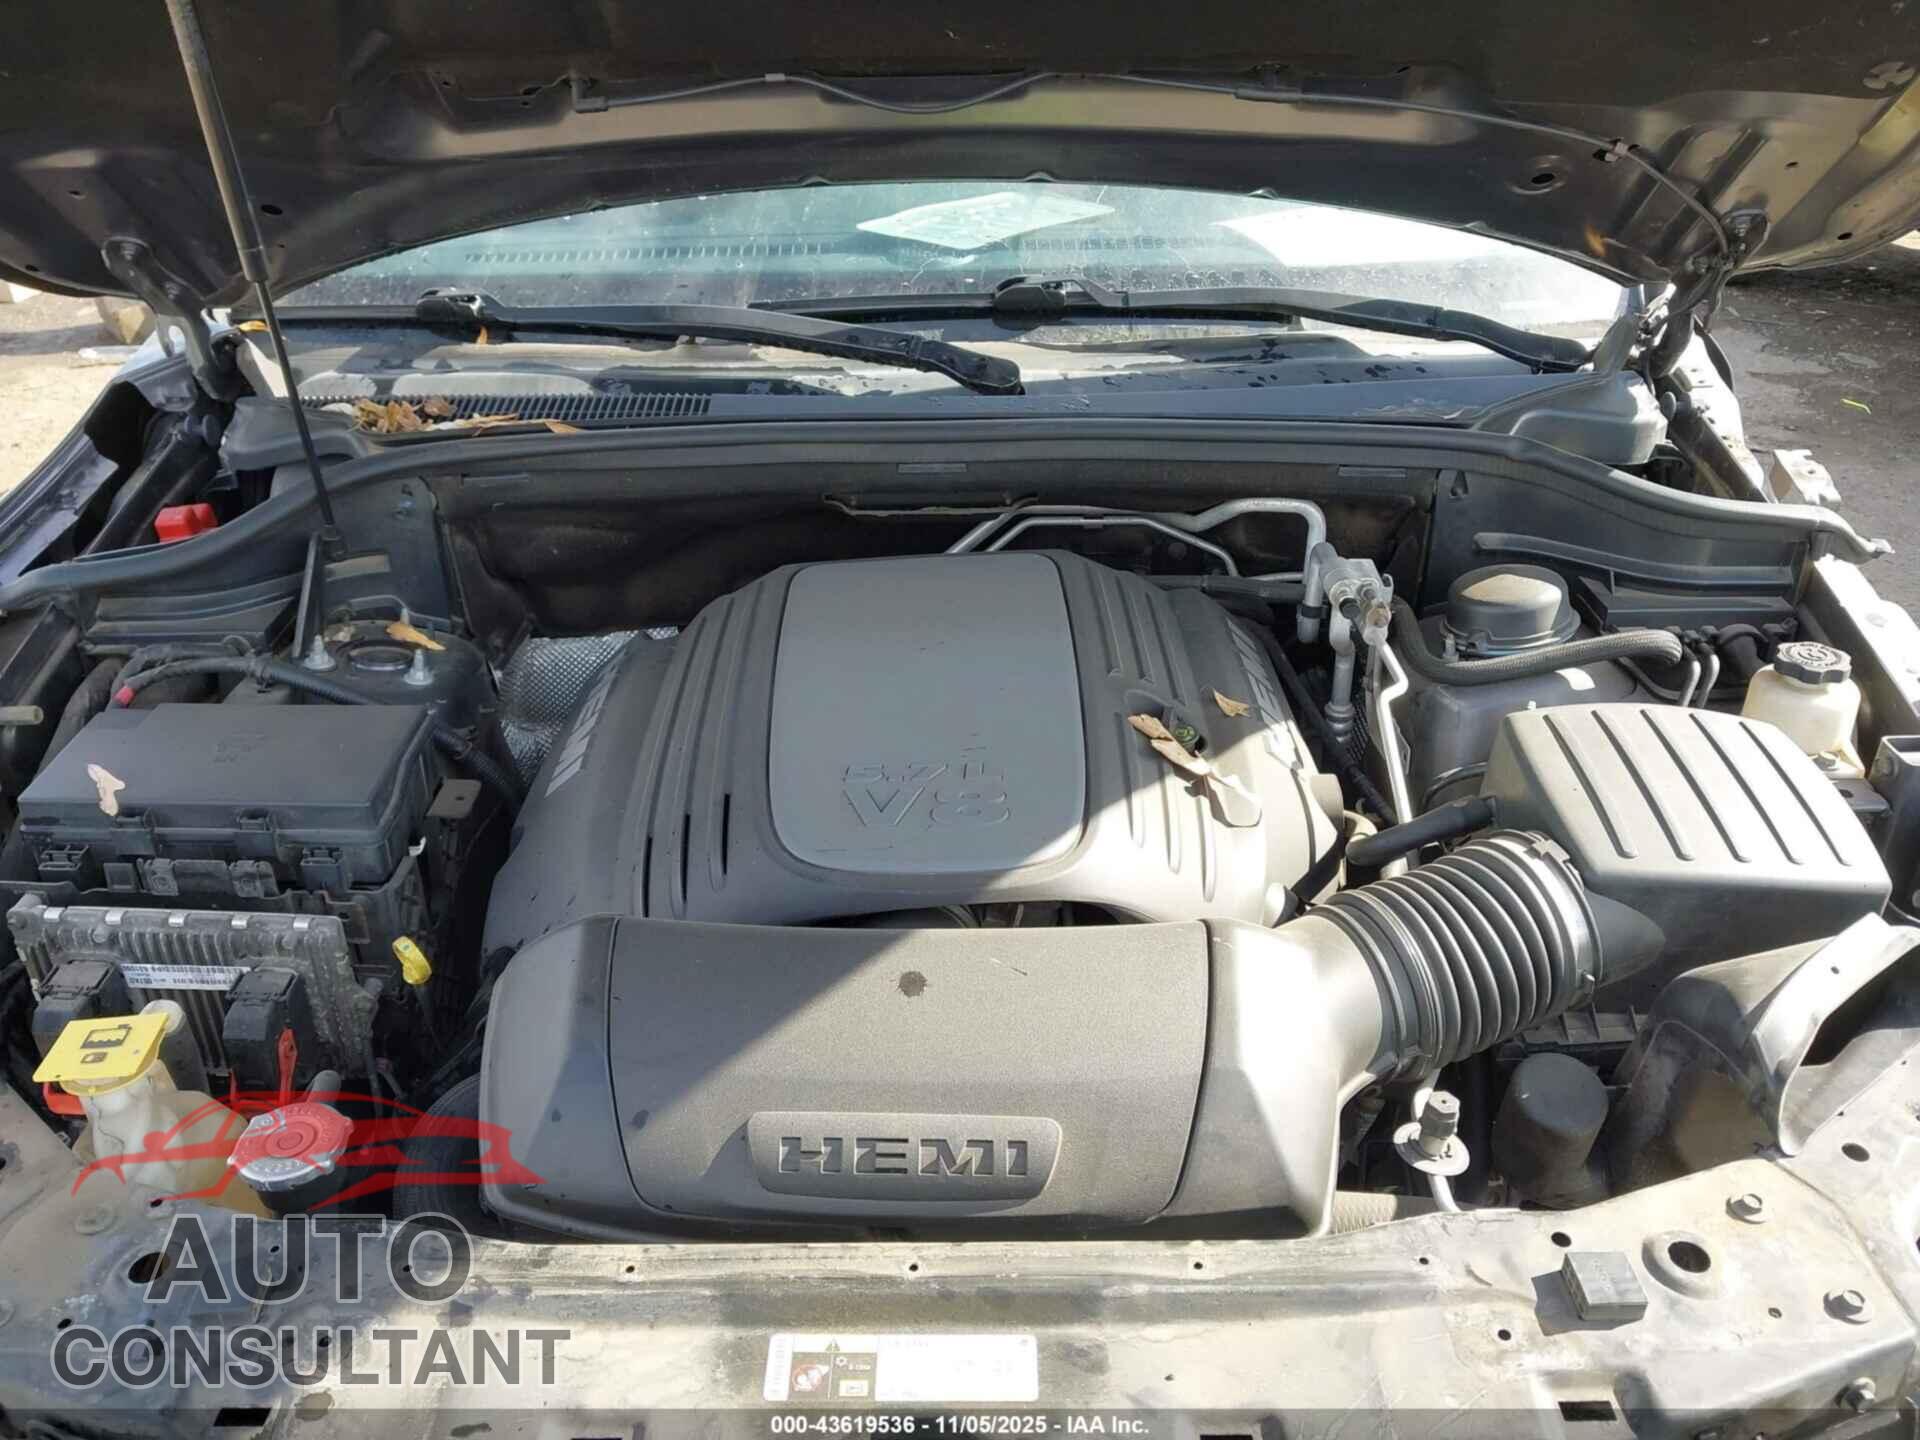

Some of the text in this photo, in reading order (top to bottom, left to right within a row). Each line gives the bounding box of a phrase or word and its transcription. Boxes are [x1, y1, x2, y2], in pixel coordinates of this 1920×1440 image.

[842, 762, 1006, 783] 5.7L
[842, 785, 1011, 827] V8
[778, 1137, 1029, 1177] HEMI
